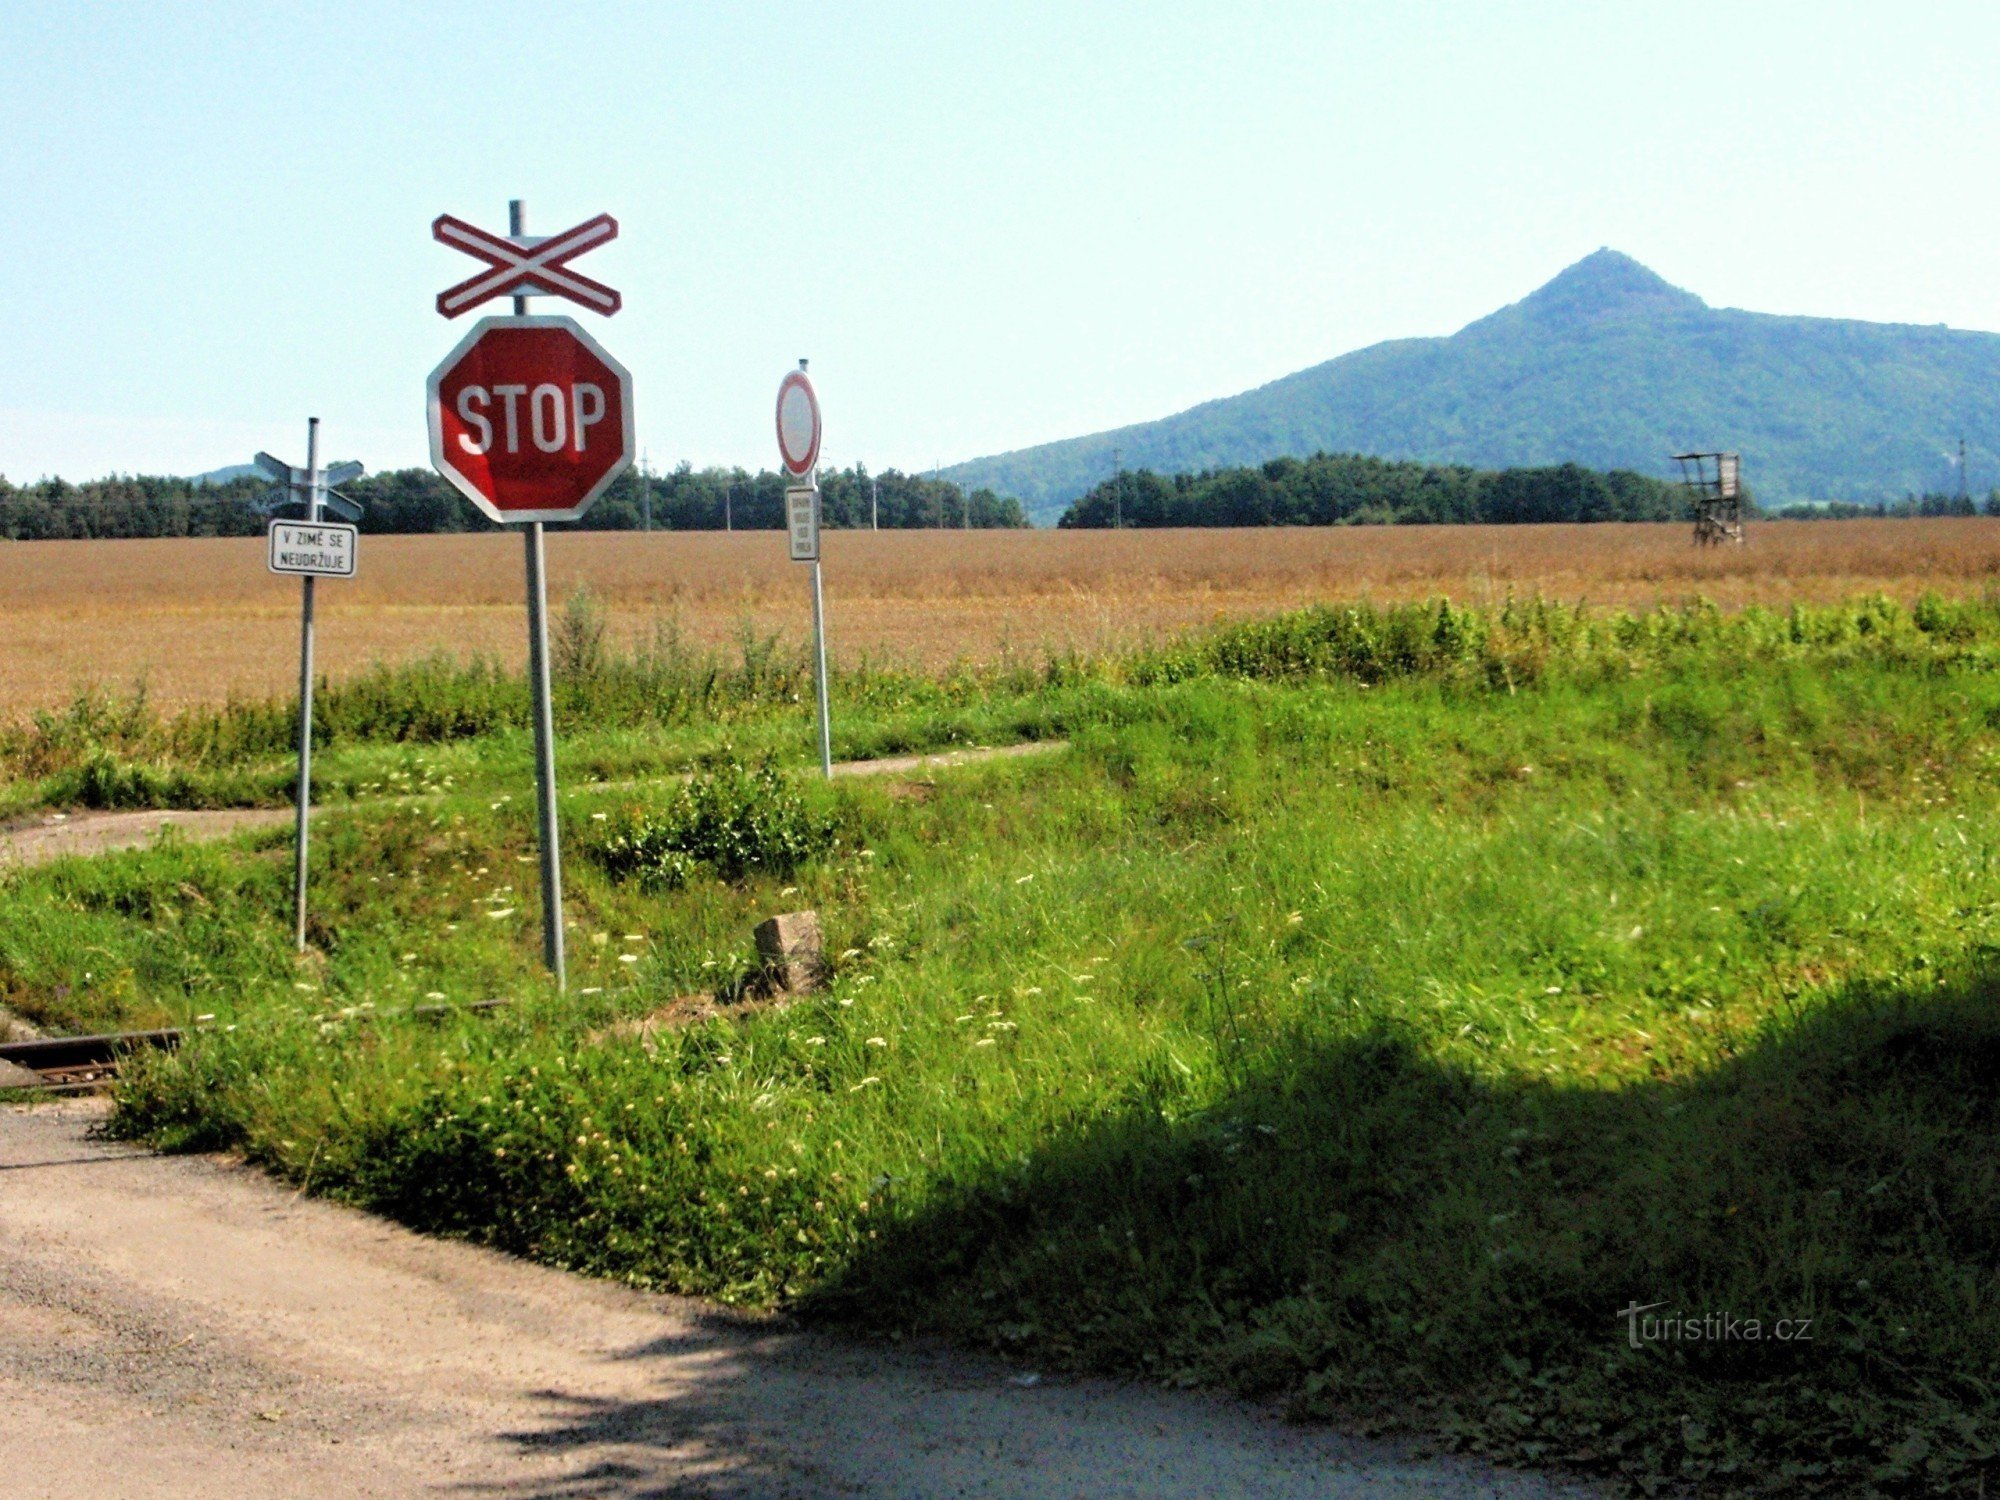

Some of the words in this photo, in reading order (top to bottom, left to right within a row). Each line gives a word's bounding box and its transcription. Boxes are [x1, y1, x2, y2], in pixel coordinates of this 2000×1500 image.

[456, 383, 605, 455] STOP
[283, 530, 291, 544] V
[297, 531, 323, 546] ZIMĚ
[329, 534, 343, 547] SE
[281, 551, 344, 569] NEUDRŽUJE
